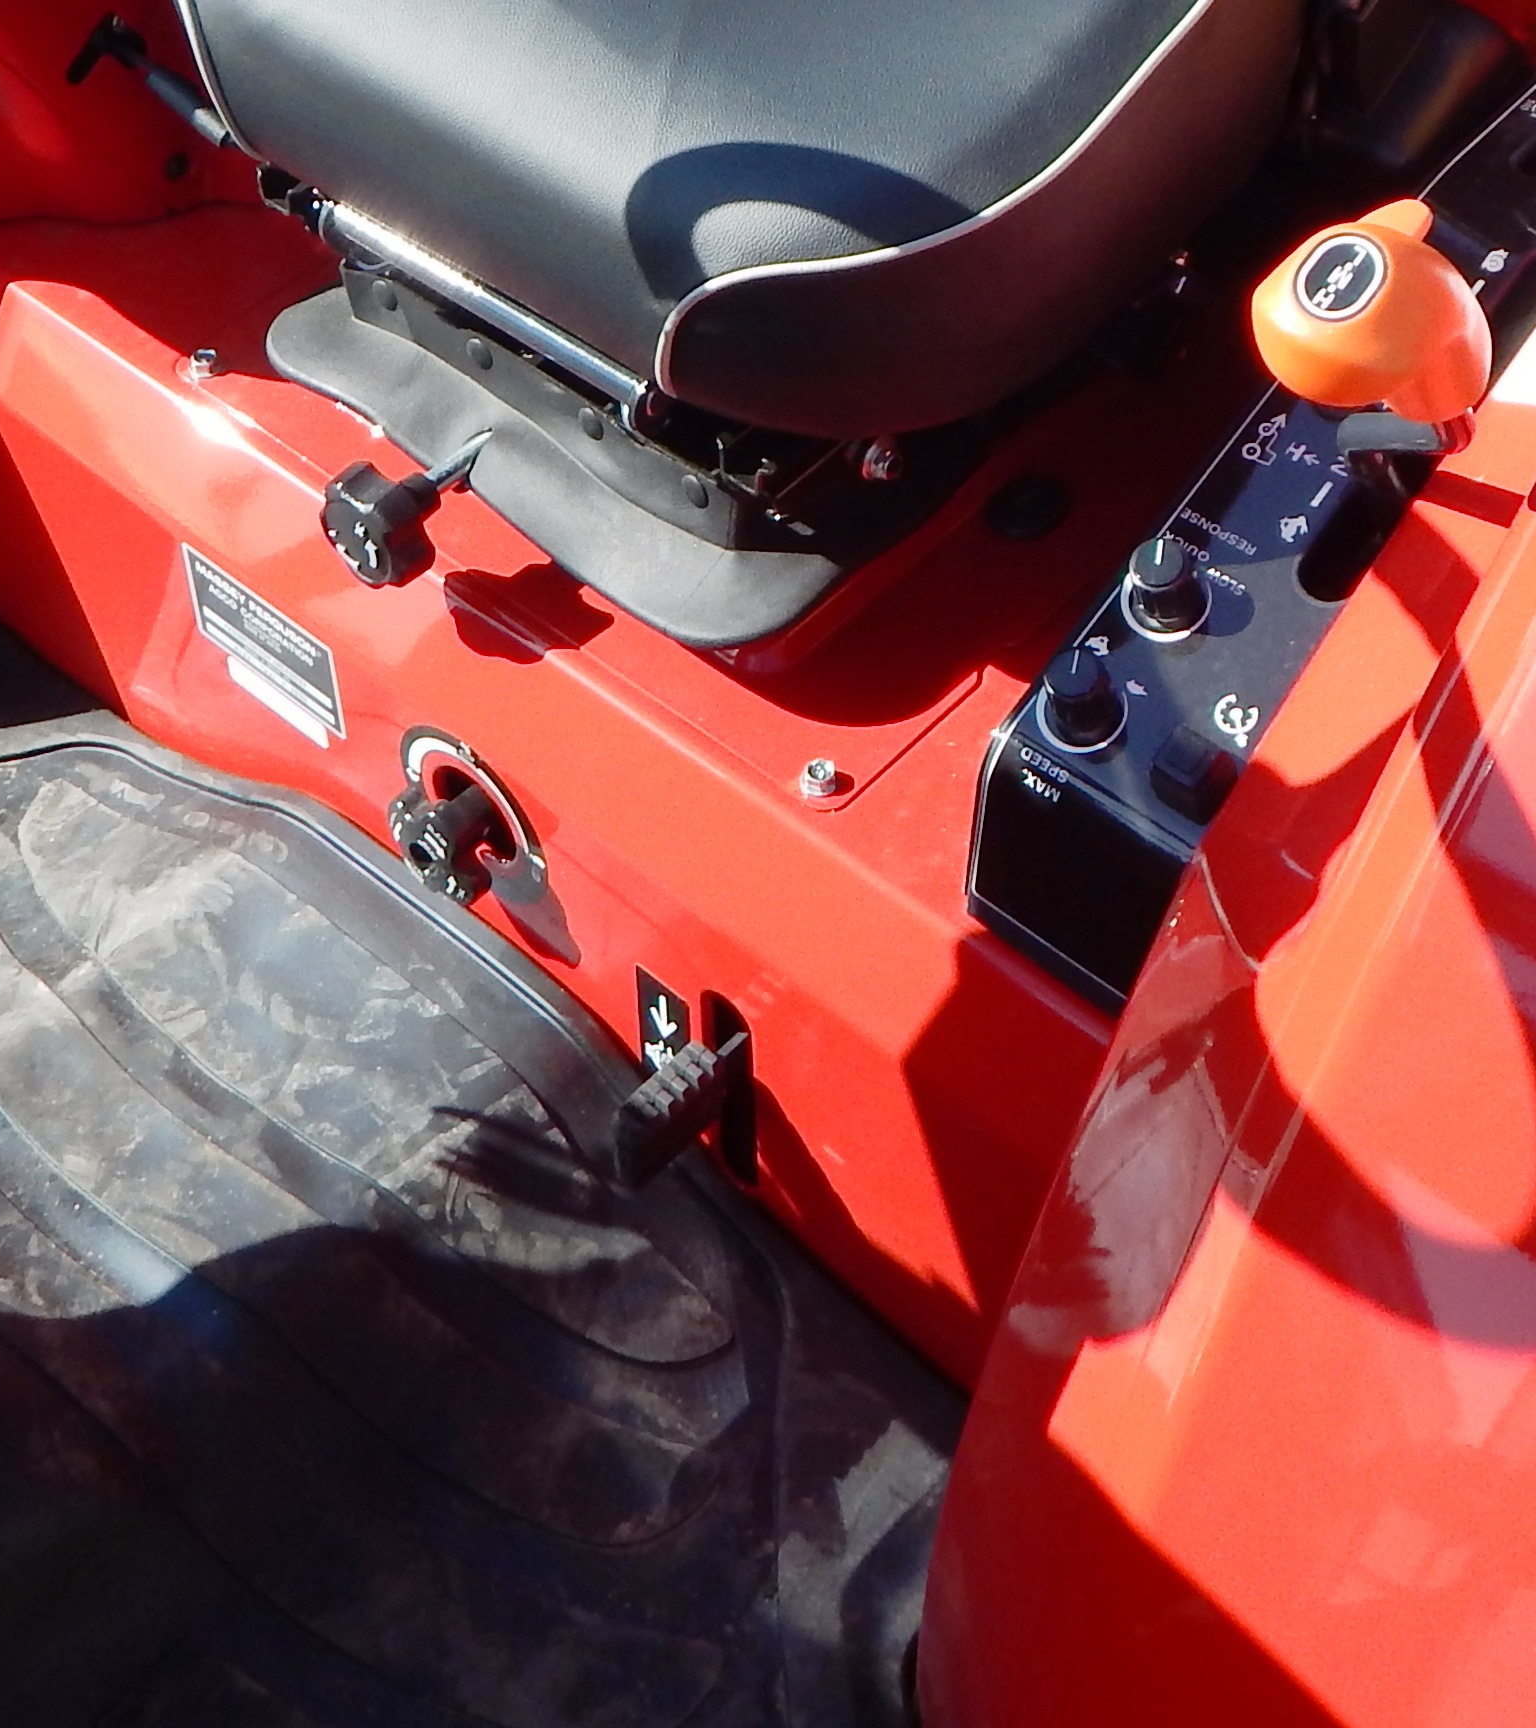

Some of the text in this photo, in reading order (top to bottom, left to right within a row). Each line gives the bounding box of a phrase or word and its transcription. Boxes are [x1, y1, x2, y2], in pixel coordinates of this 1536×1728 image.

[1180, 507, 1257, 556] RESPONSE
[1207, 568, 1246, 596] SLOW
[1020, 746, 1070, 783] SPEED
[1022, 768, 1061, 803] MAX.
